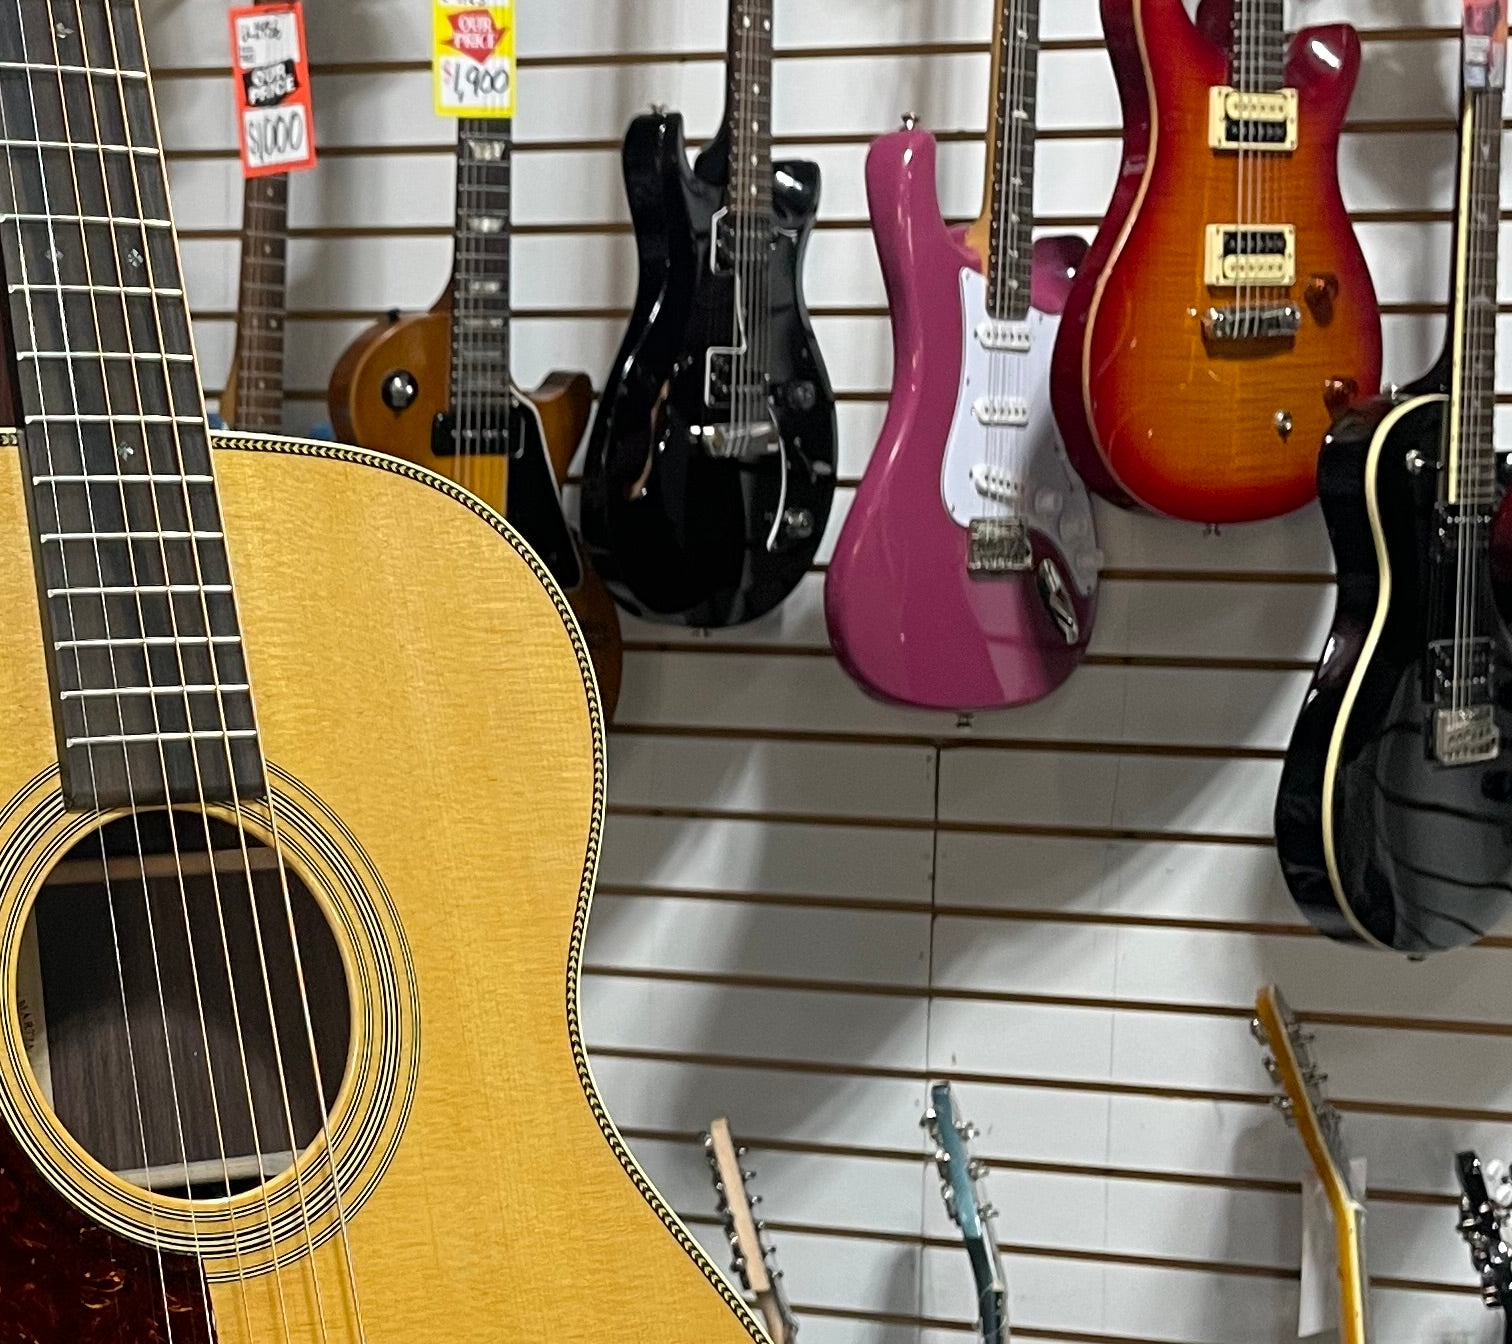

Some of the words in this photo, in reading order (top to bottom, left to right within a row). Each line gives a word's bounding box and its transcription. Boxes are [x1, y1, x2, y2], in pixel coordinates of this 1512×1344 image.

[457, 14, 493, 33] OUR
[453, 32, 497, 49] PRICE
[251, 62, 287, 87] OUR
[248, 73, 297, 105] PRICE
